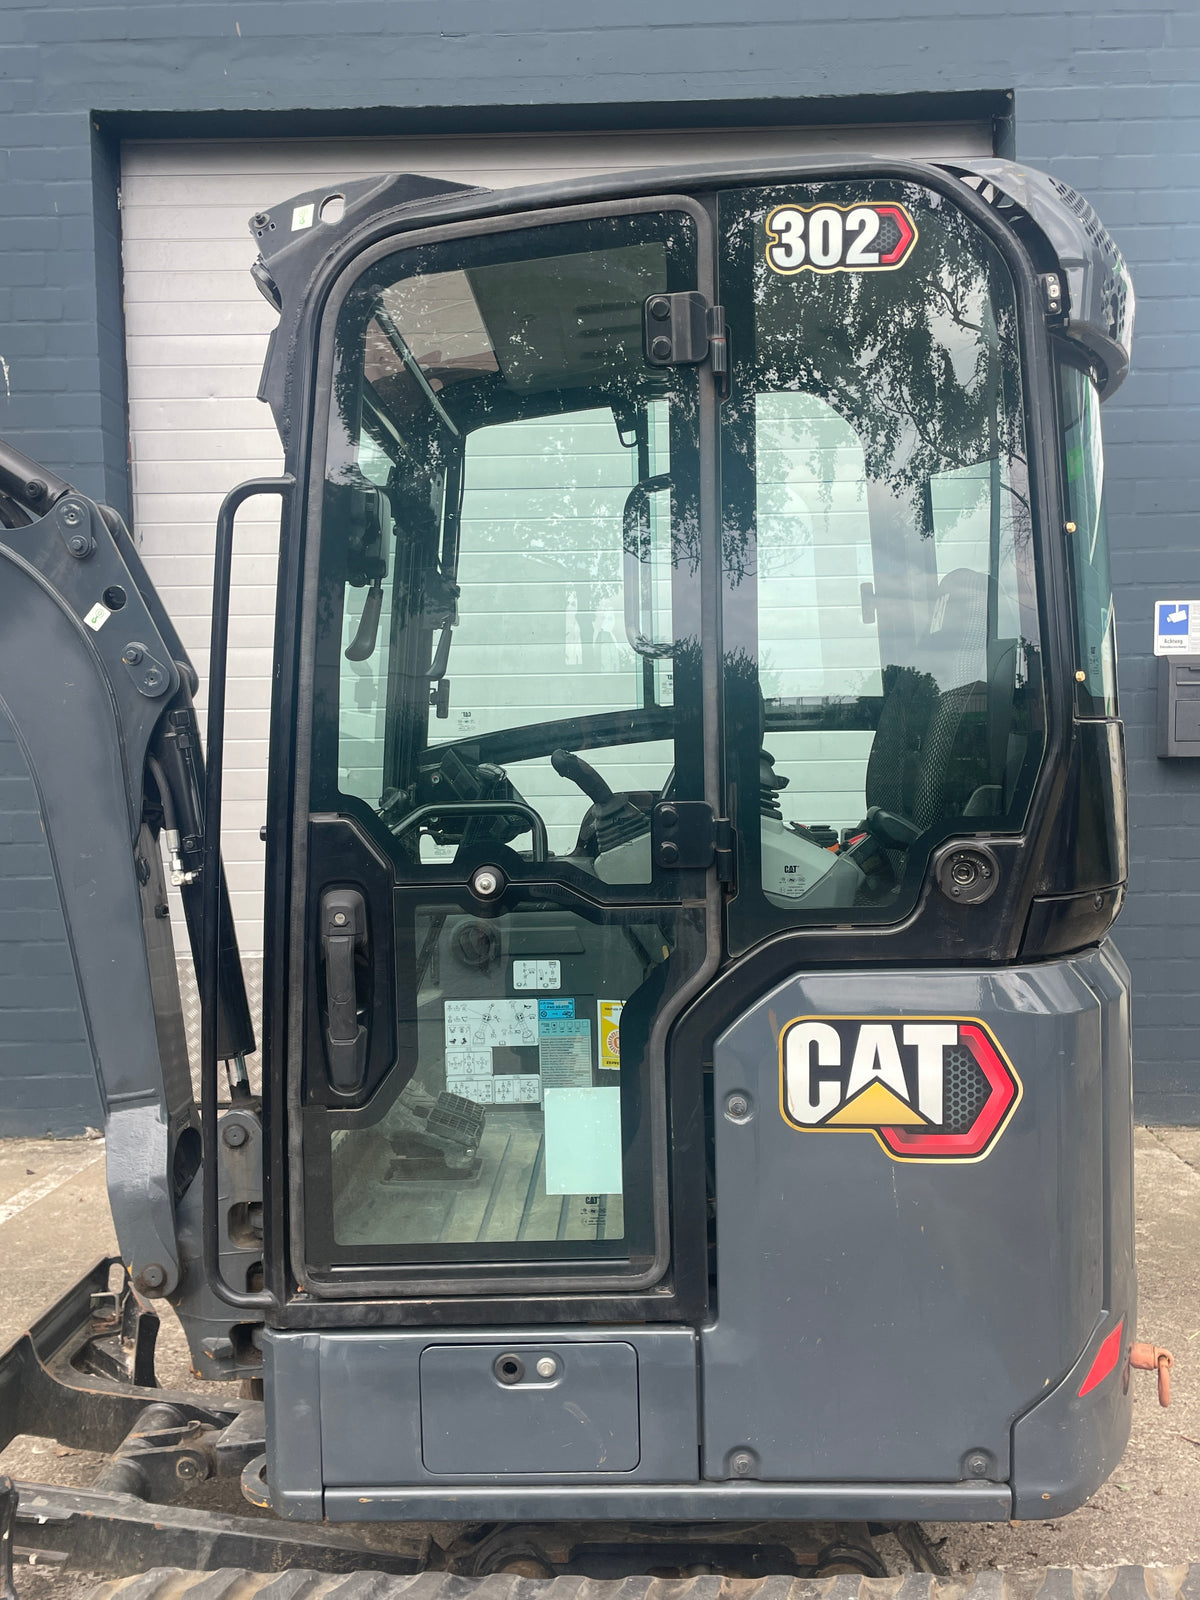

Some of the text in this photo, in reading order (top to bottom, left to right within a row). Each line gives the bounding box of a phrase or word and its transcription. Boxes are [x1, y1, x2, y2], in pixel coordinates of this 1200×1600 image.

[771, 208, 880, 268] 302
[784, 865, 798, 874] CAT
[786, 1022, 958, 1125] CAT
[585, 1196, 598, 1205] CAT
